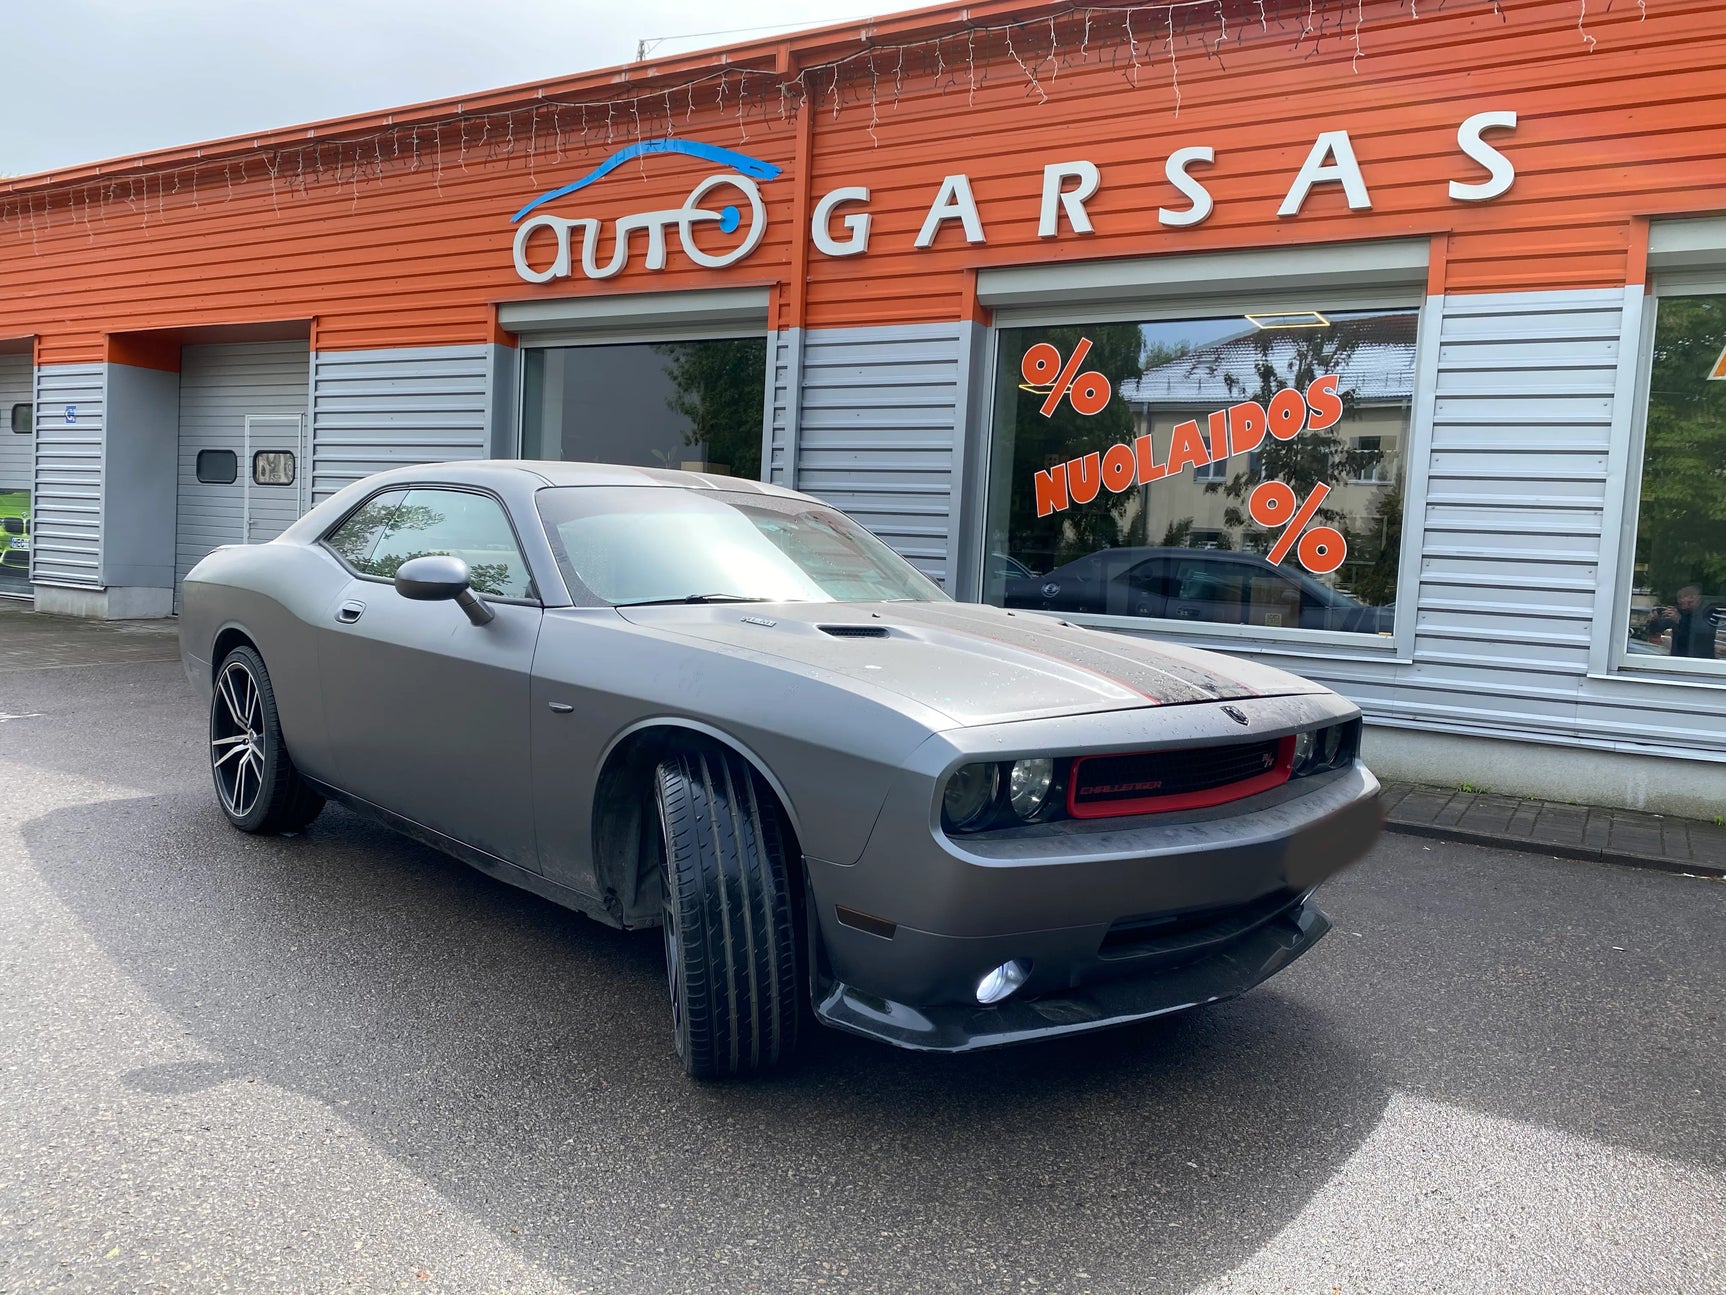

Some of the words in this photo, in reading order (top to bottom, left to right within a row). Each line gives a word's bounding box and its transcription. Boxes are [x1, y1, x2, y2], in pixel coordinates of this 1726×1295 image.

[811, 110, 1518, 257] GARSAS
[1034, 374, 1344, 518] NUOLAIDOS
[1079, 780, 1163, 795] CHALLENGER
